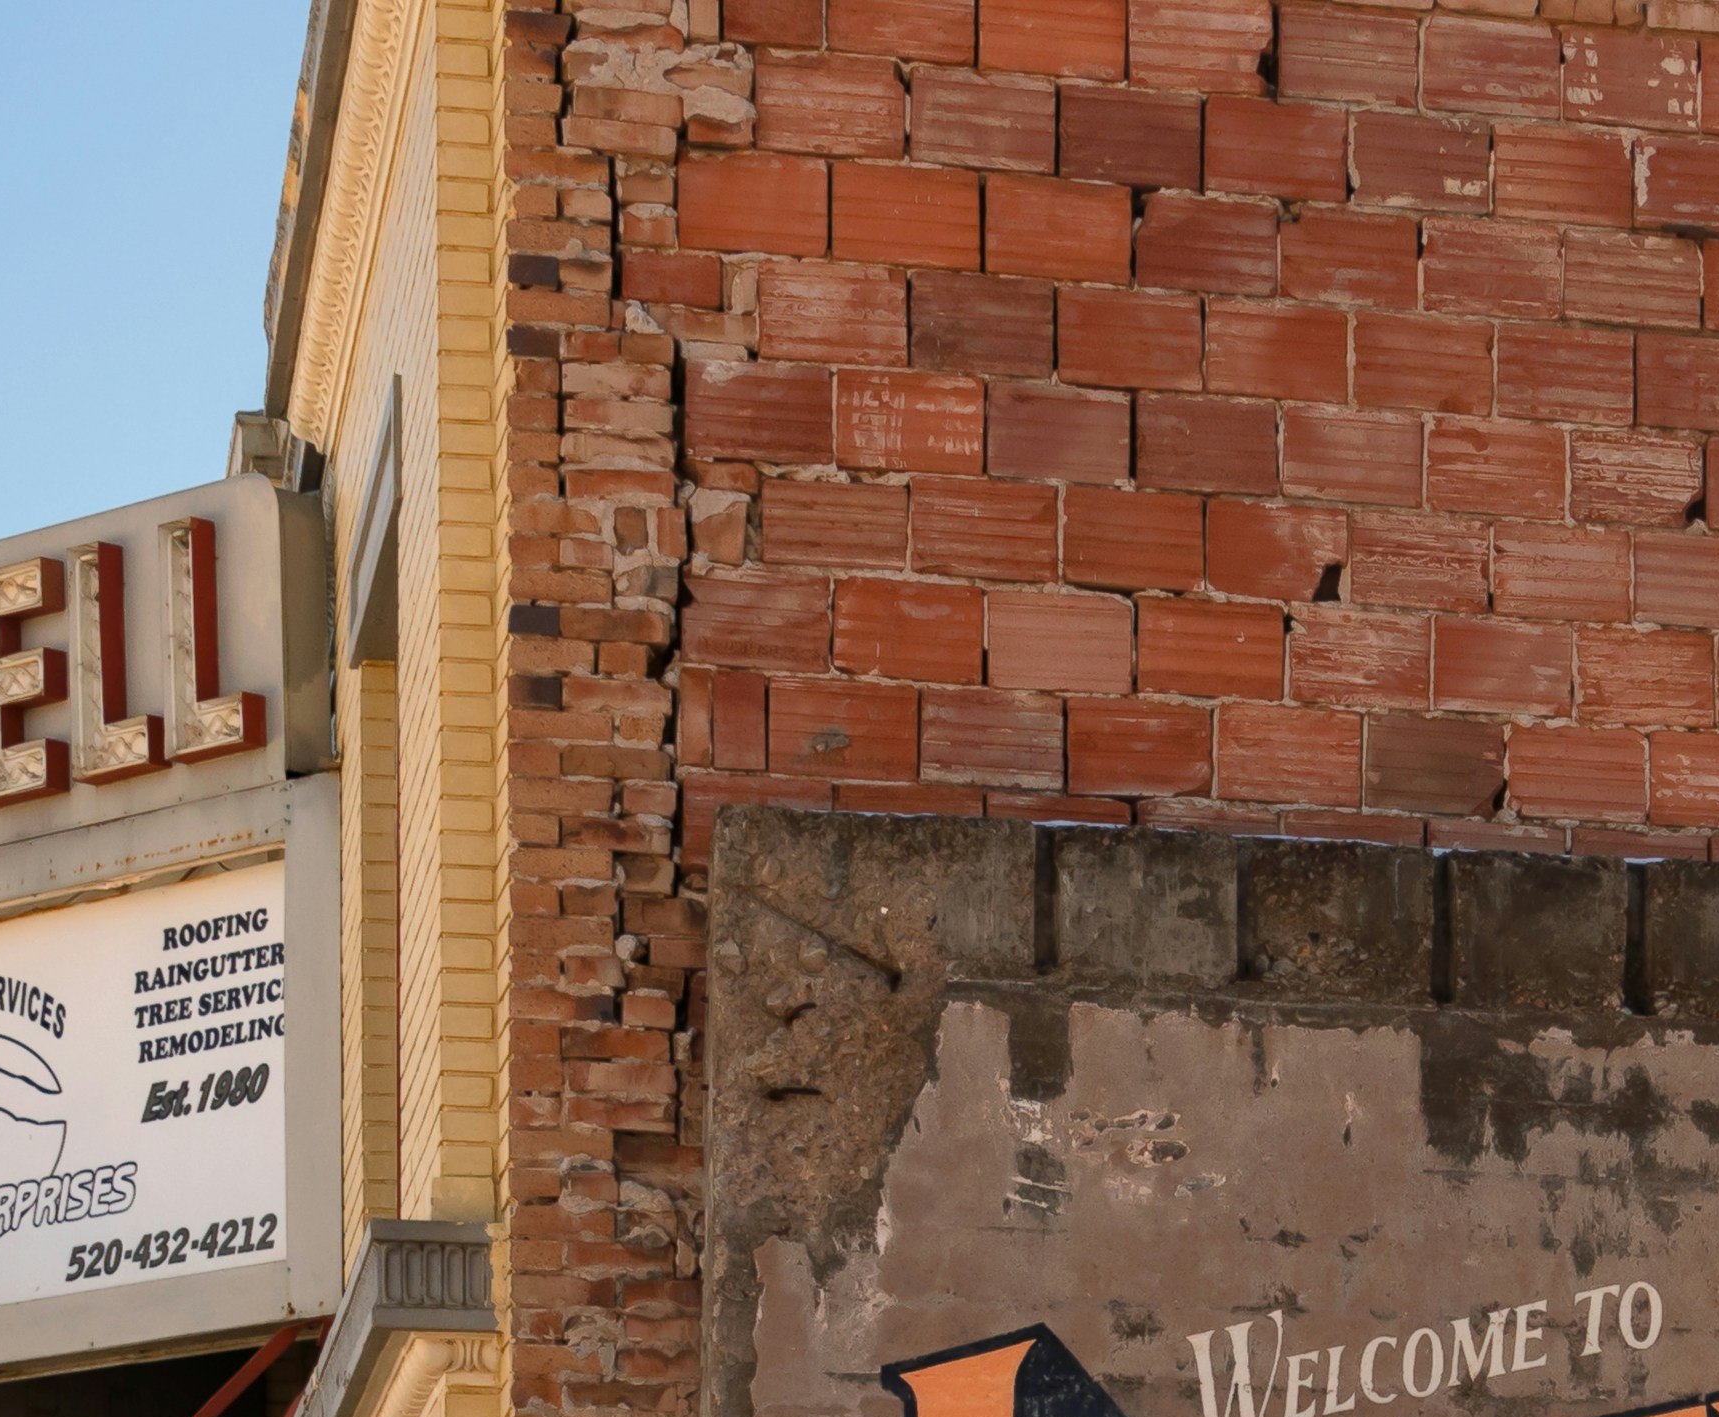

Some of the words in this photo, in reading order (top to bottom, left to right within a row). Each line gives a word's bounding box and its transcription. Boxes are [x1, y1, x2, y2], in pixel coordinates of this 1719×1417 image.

[162, 908, 268, 950] ROOFING
[134, 997, 192, 1028] TREE
[198, 978, 284, 1016] SERVIC
[141, 1080, 192, 1123] Est.
[197, 1063, 269, 1113] 1980
[65, 1213, 278, 1282] 520-432-4212
[1574, 1281, 1663, 1357] TO
